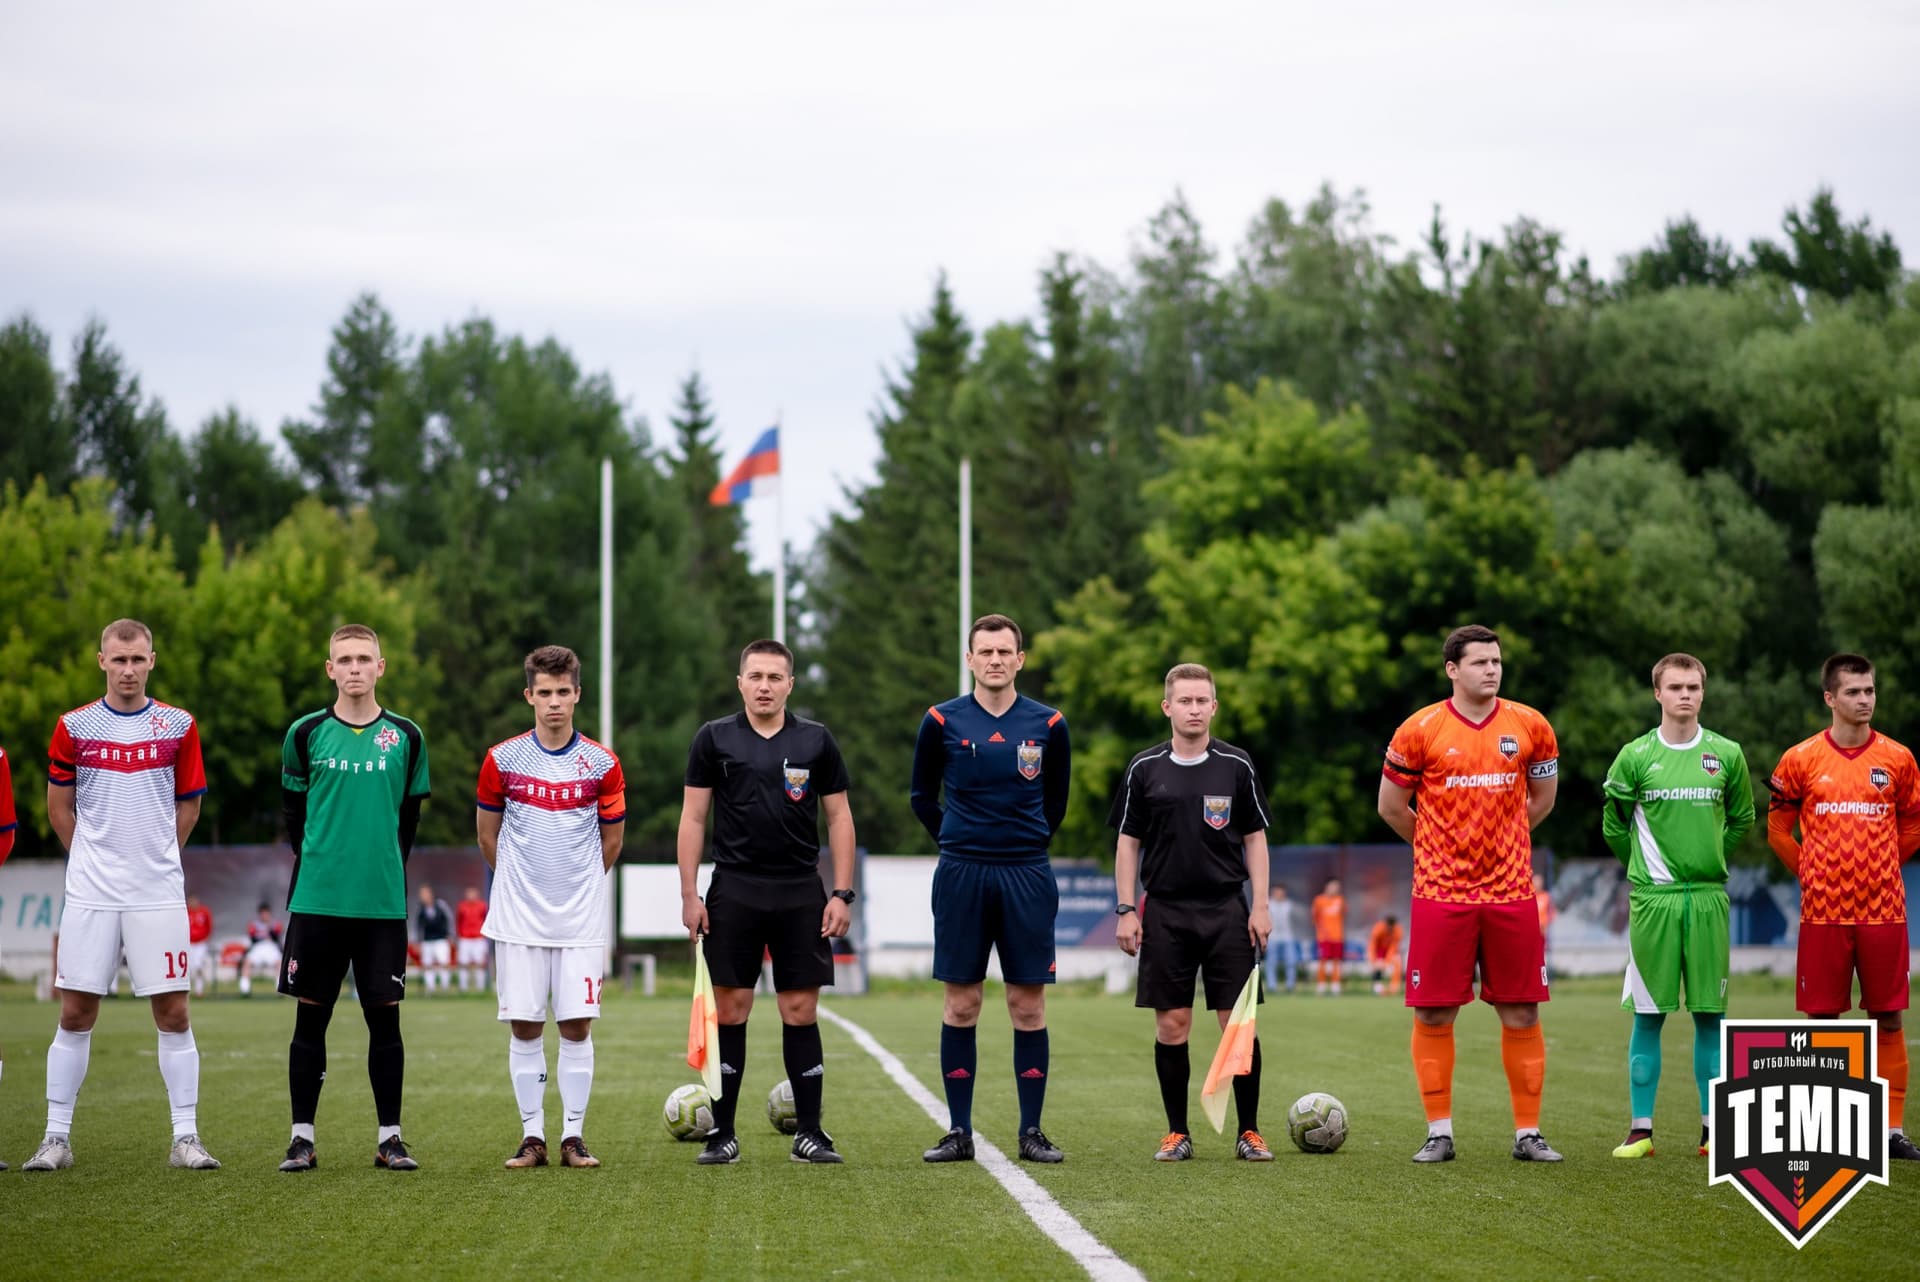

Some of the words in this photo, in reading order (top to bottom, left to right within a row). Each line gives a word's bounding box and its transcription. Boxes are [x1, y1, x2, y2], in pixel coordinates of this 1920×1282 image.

[1445, 772, 1518, 789] ПРОДИНВЕСТ
[1815, 801, 1889, 816] ПРОДИНВЕСТ
[164, 951, 188, 979] 19
